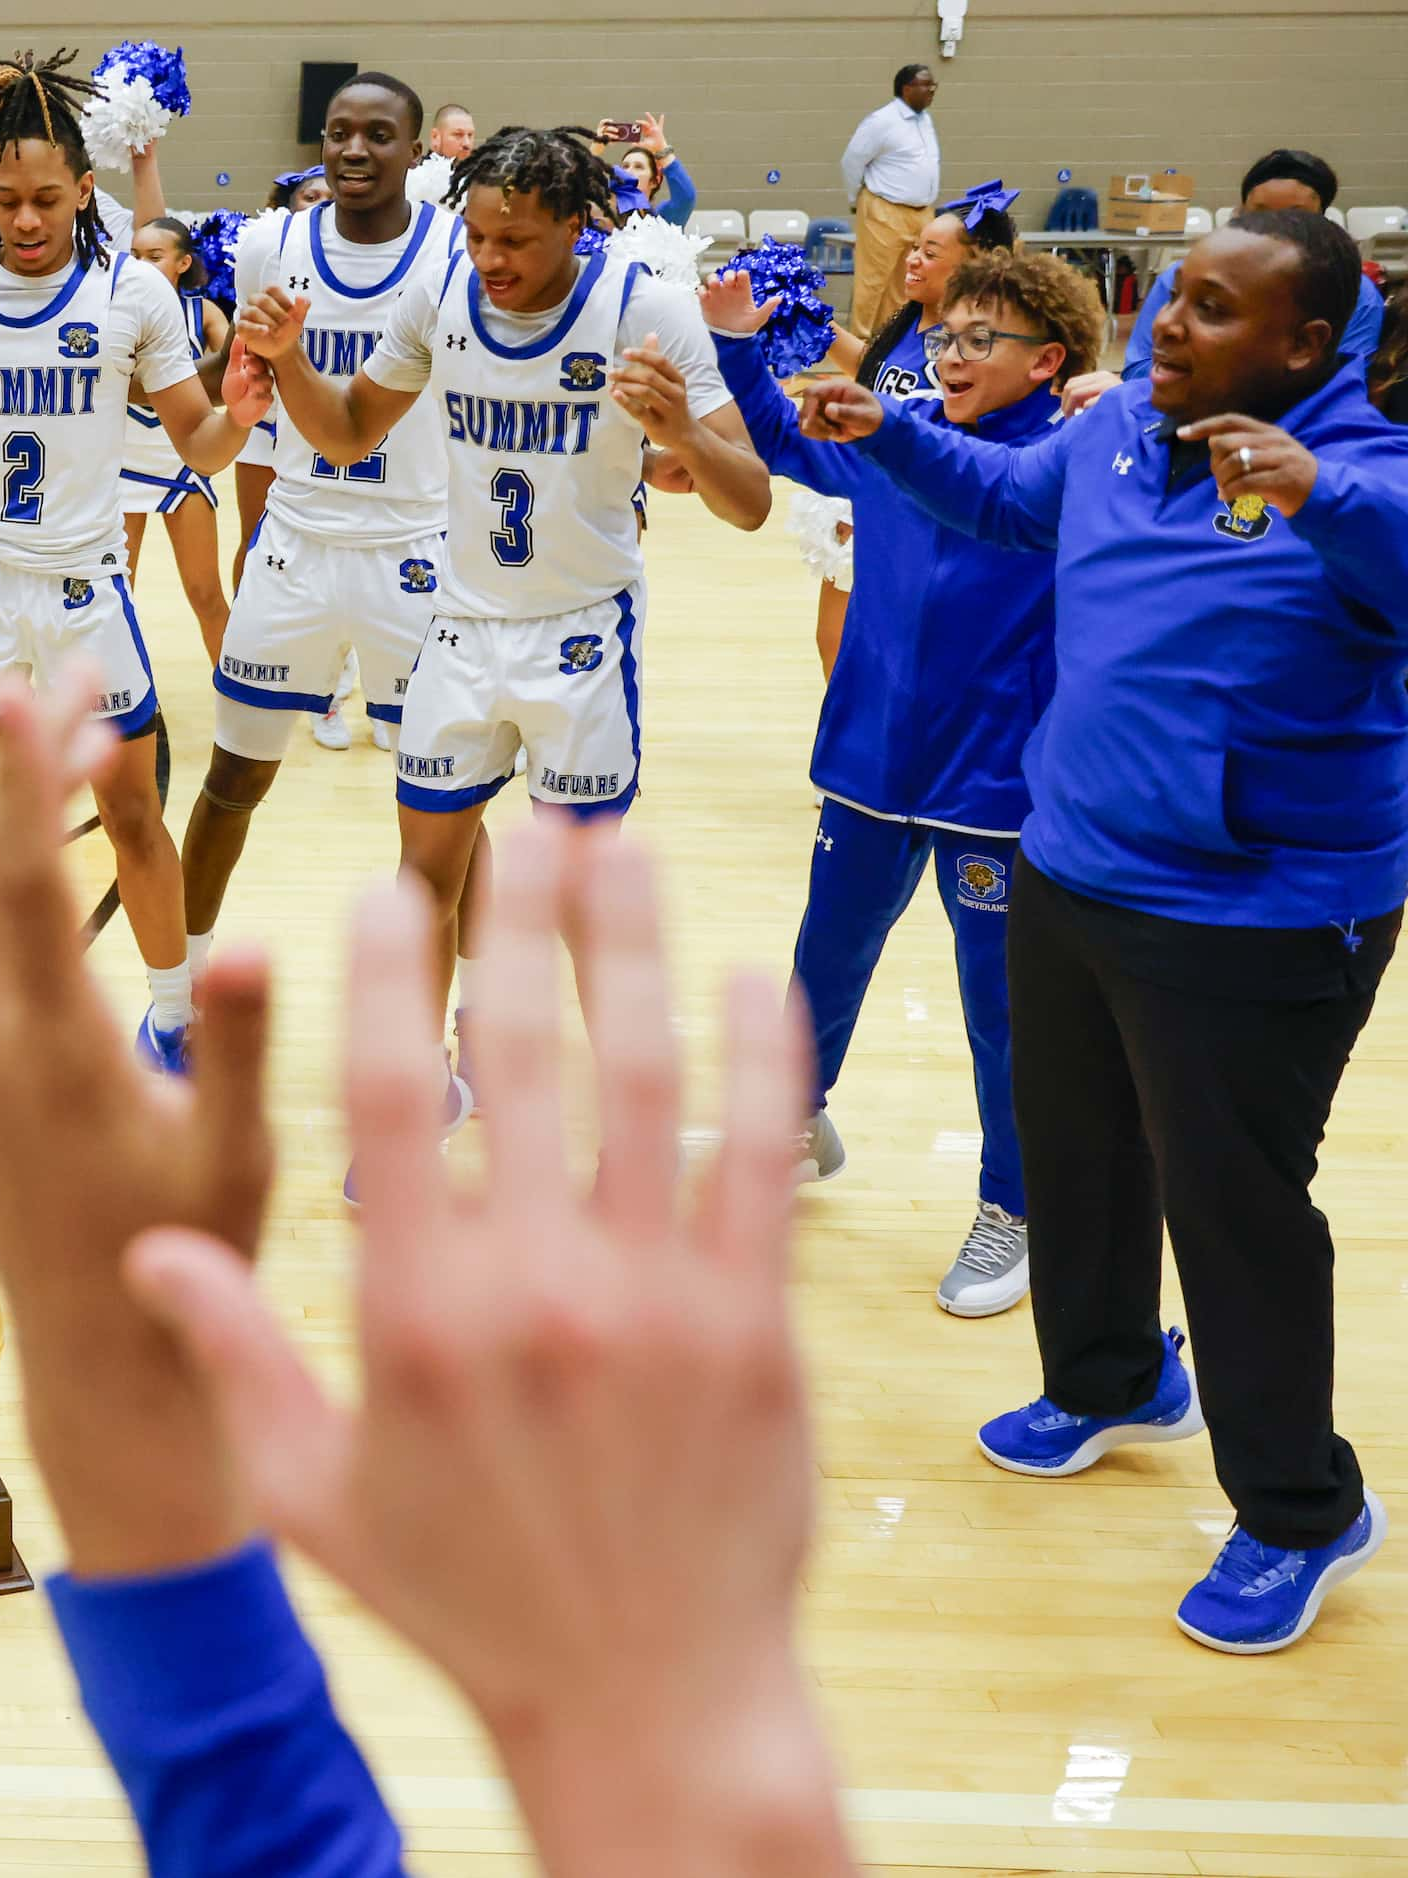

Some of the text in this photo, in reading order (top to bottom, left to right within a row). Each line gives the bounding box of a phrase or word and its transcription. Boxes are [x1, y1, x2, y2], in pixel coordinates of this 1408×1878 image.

[445, 390, 600, 455] SUMMIT
[0, 431, 45, 524] 2
[490, 467, 535, 567] 3
[223, 655, 290, 682] SUMMIT
[96, 689, 132, 712] ARS
[541, 767, 619, 797] JAGUARS
